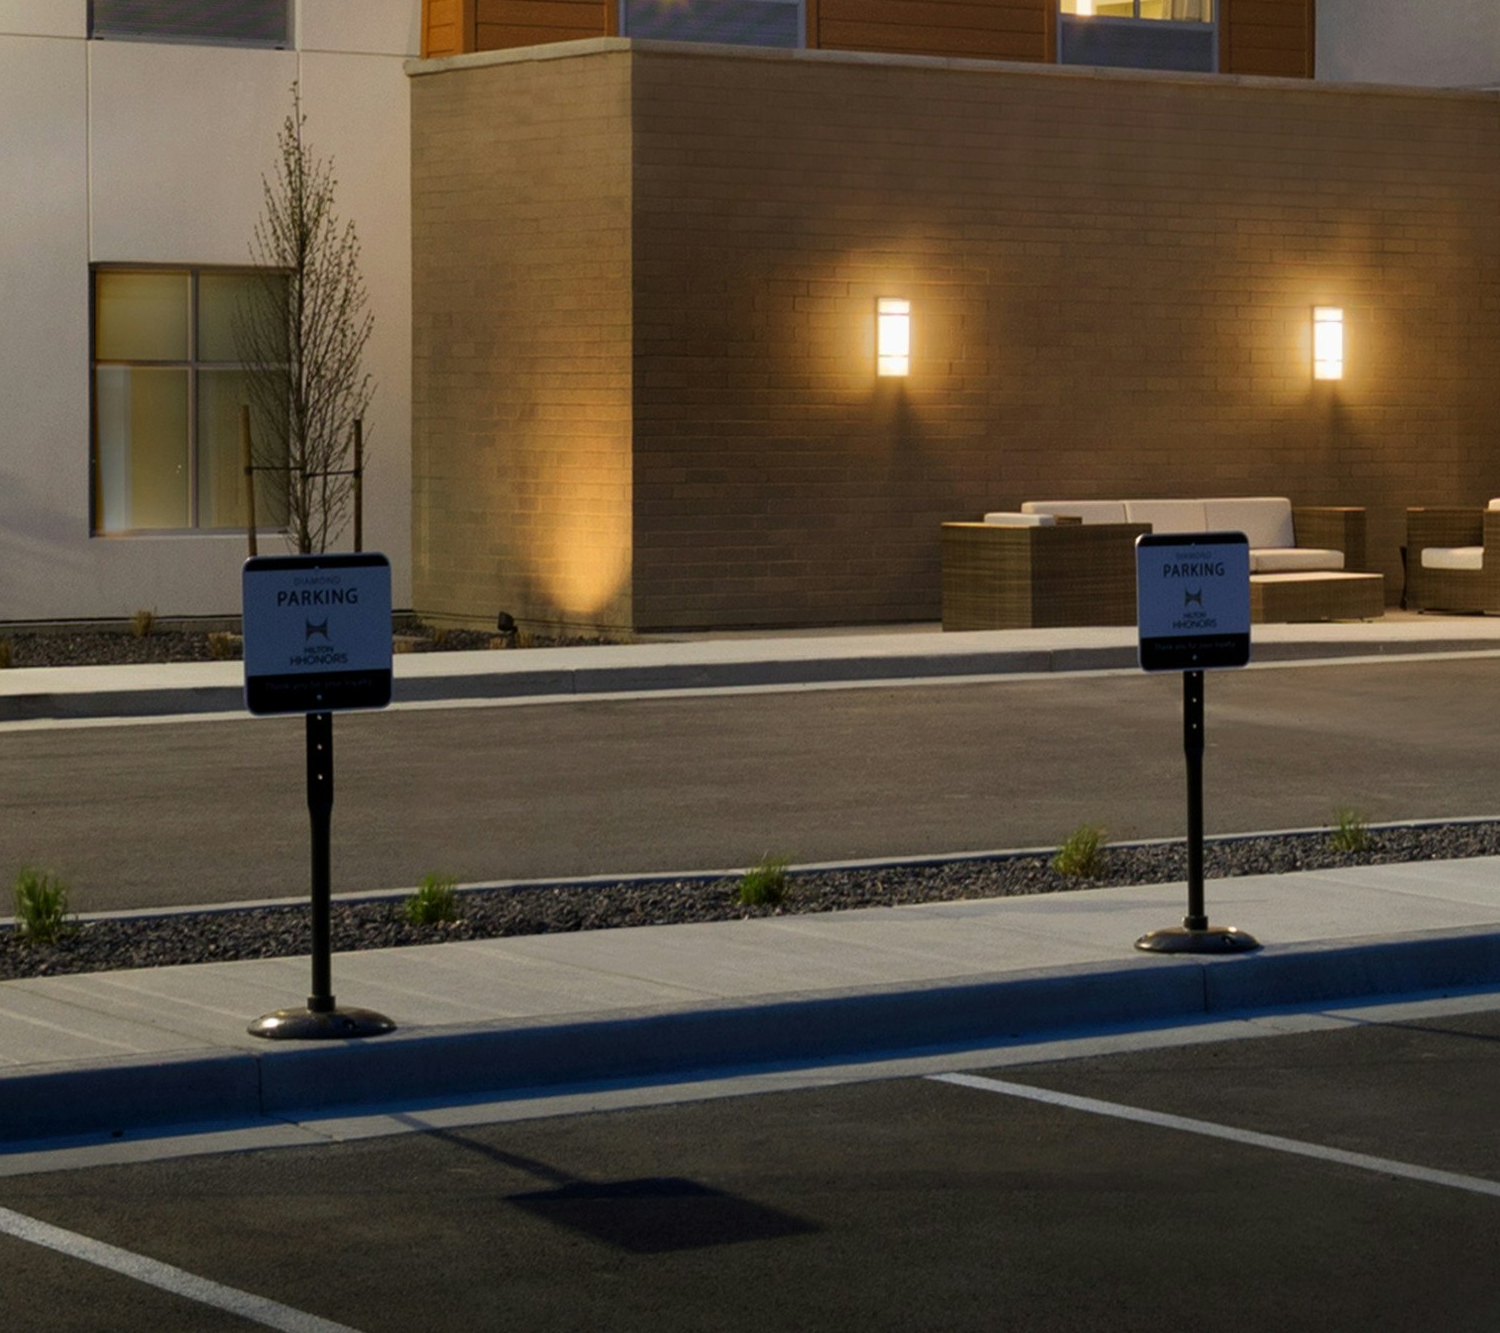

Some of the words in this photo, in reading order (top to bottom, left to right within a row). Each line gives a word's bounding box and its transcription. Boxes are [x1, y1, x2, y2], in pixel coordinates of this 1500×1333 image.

[1163, 561, 1225, 578] PARKING
[277, 587, 358, 607] PARKING
[289, 653, 348, 666] HHONORS
